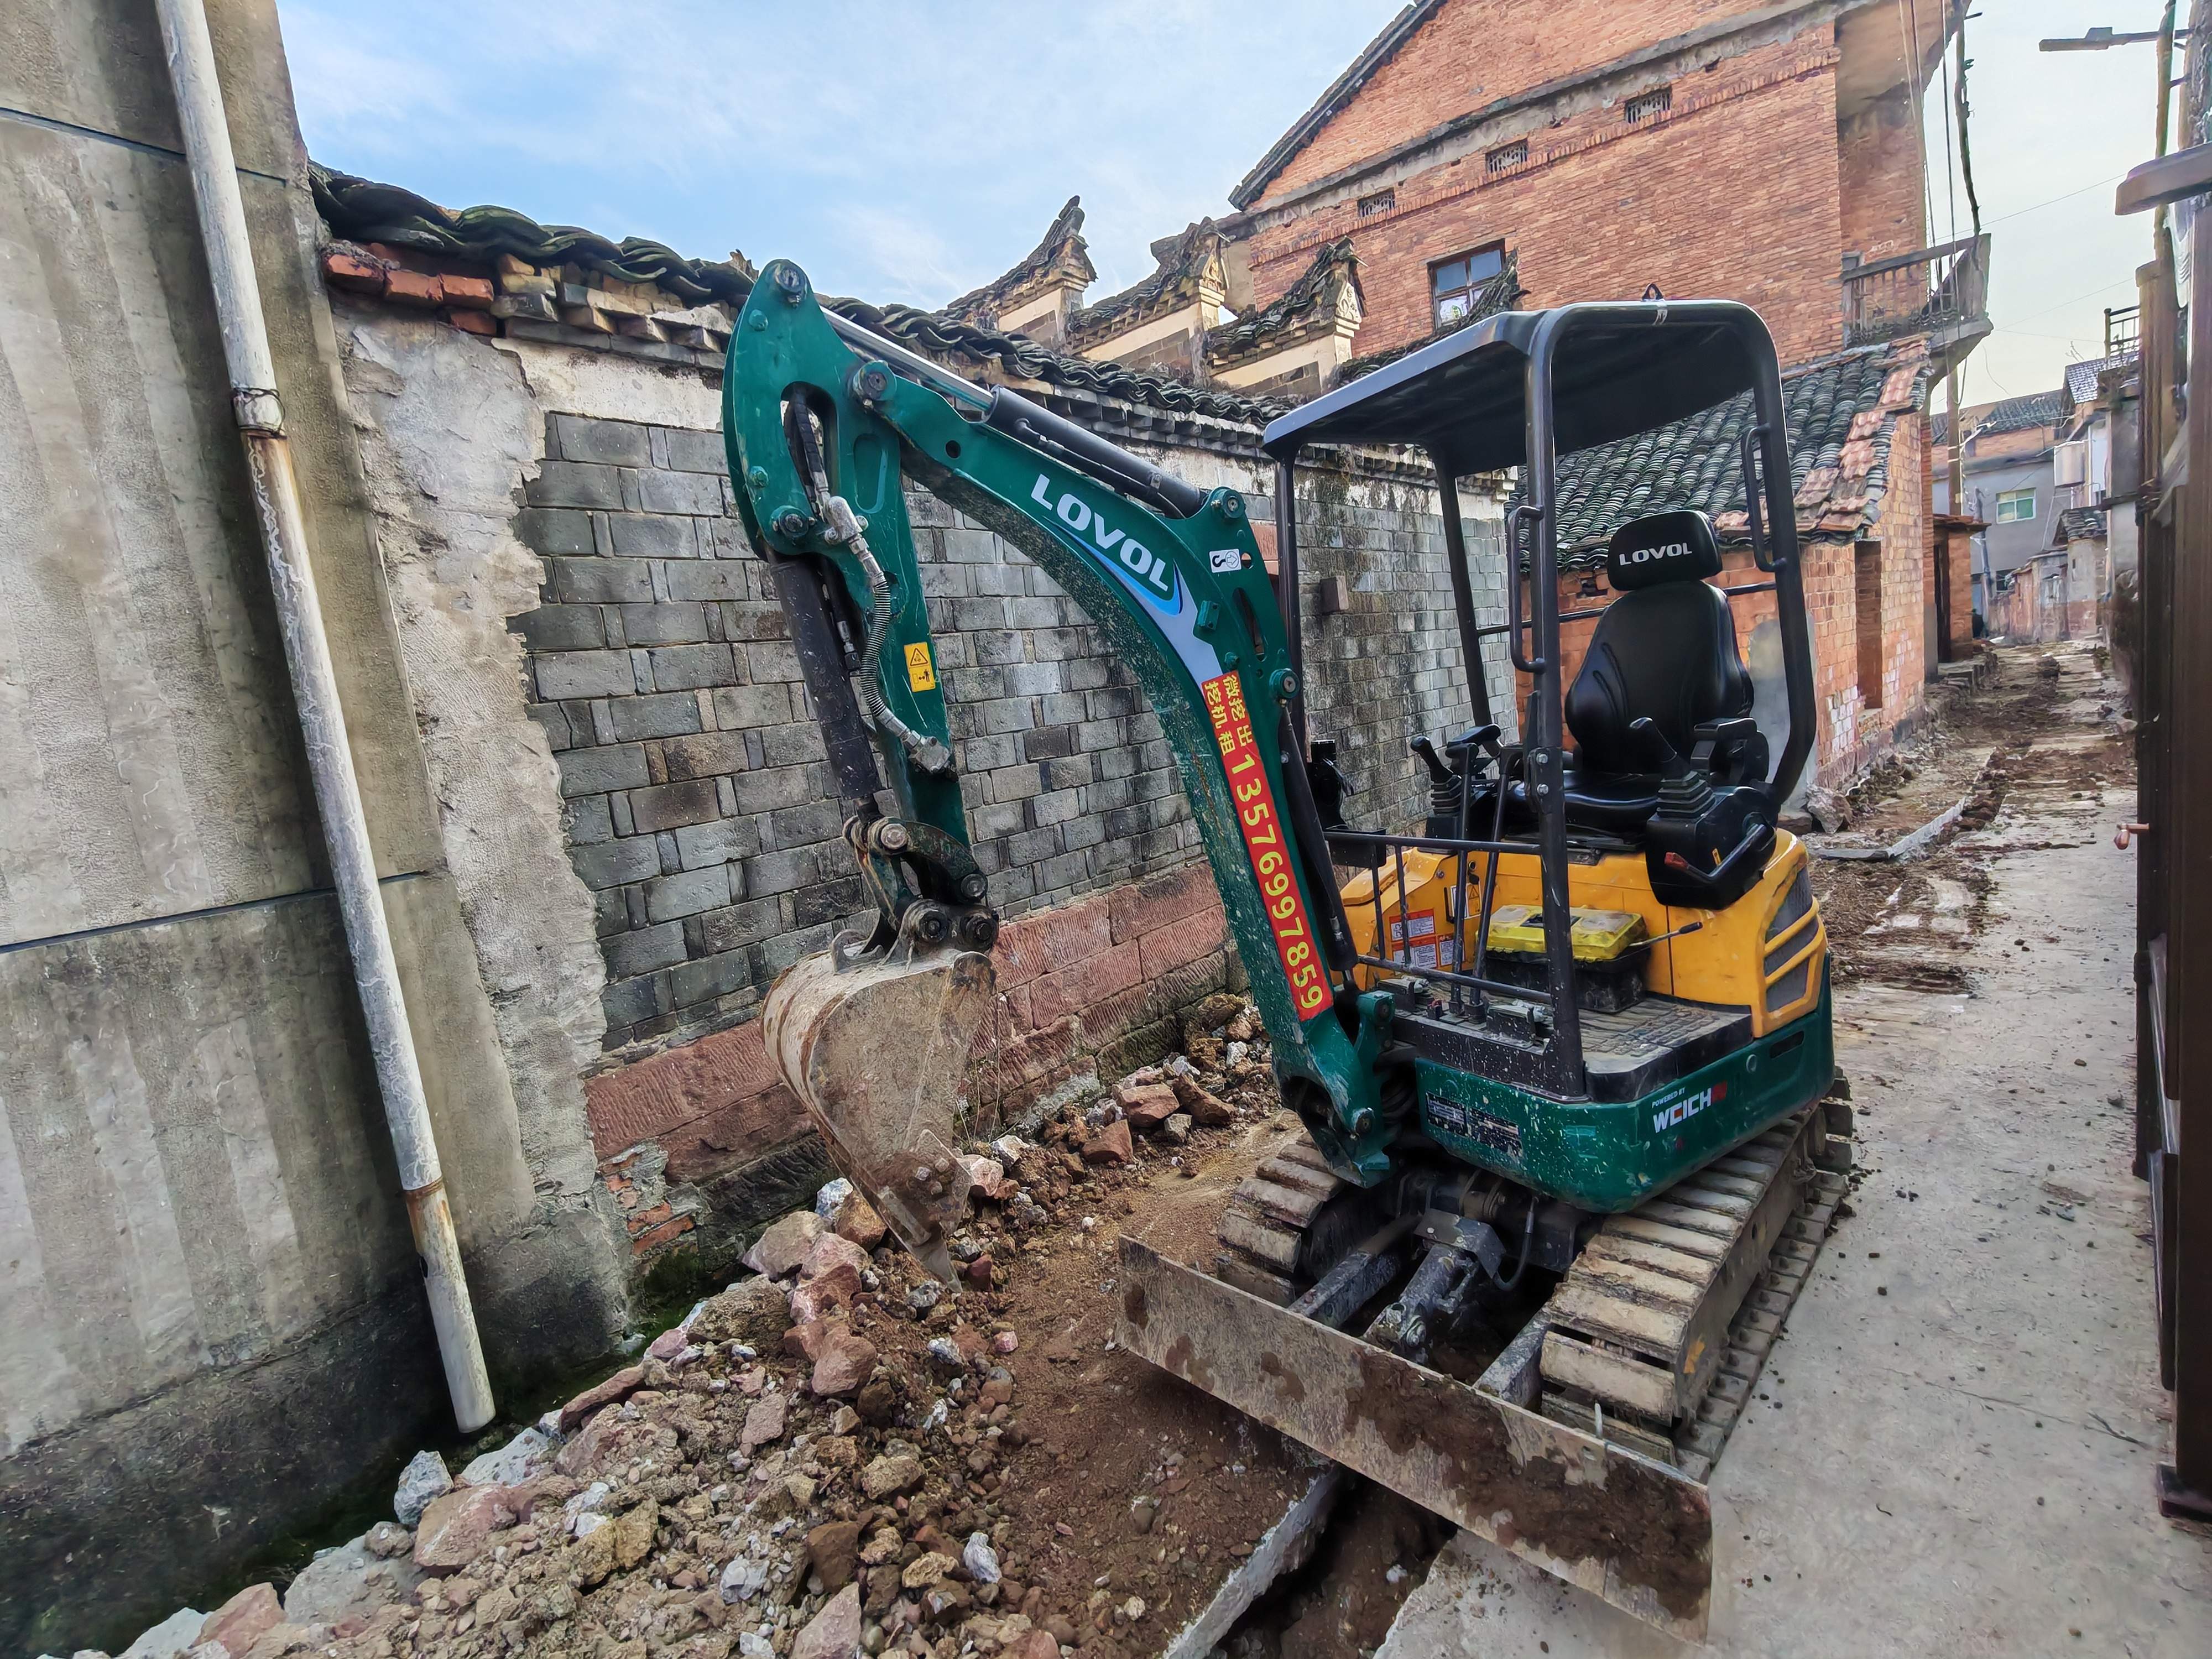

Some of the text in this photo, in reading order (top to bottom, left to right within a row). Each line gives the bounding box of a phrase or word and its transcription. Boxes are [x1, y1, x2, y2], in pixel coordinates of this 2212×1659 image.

[1031, 473, 1168, 592] LOVOL
[1619, 542, 1692, 566] LOVOL
[1232, 754, 1323, 1009] 13576997859
[1652, 1091, 1678, 1109] POWERED
[1653, 1080, 1728, 1134] WEICH
